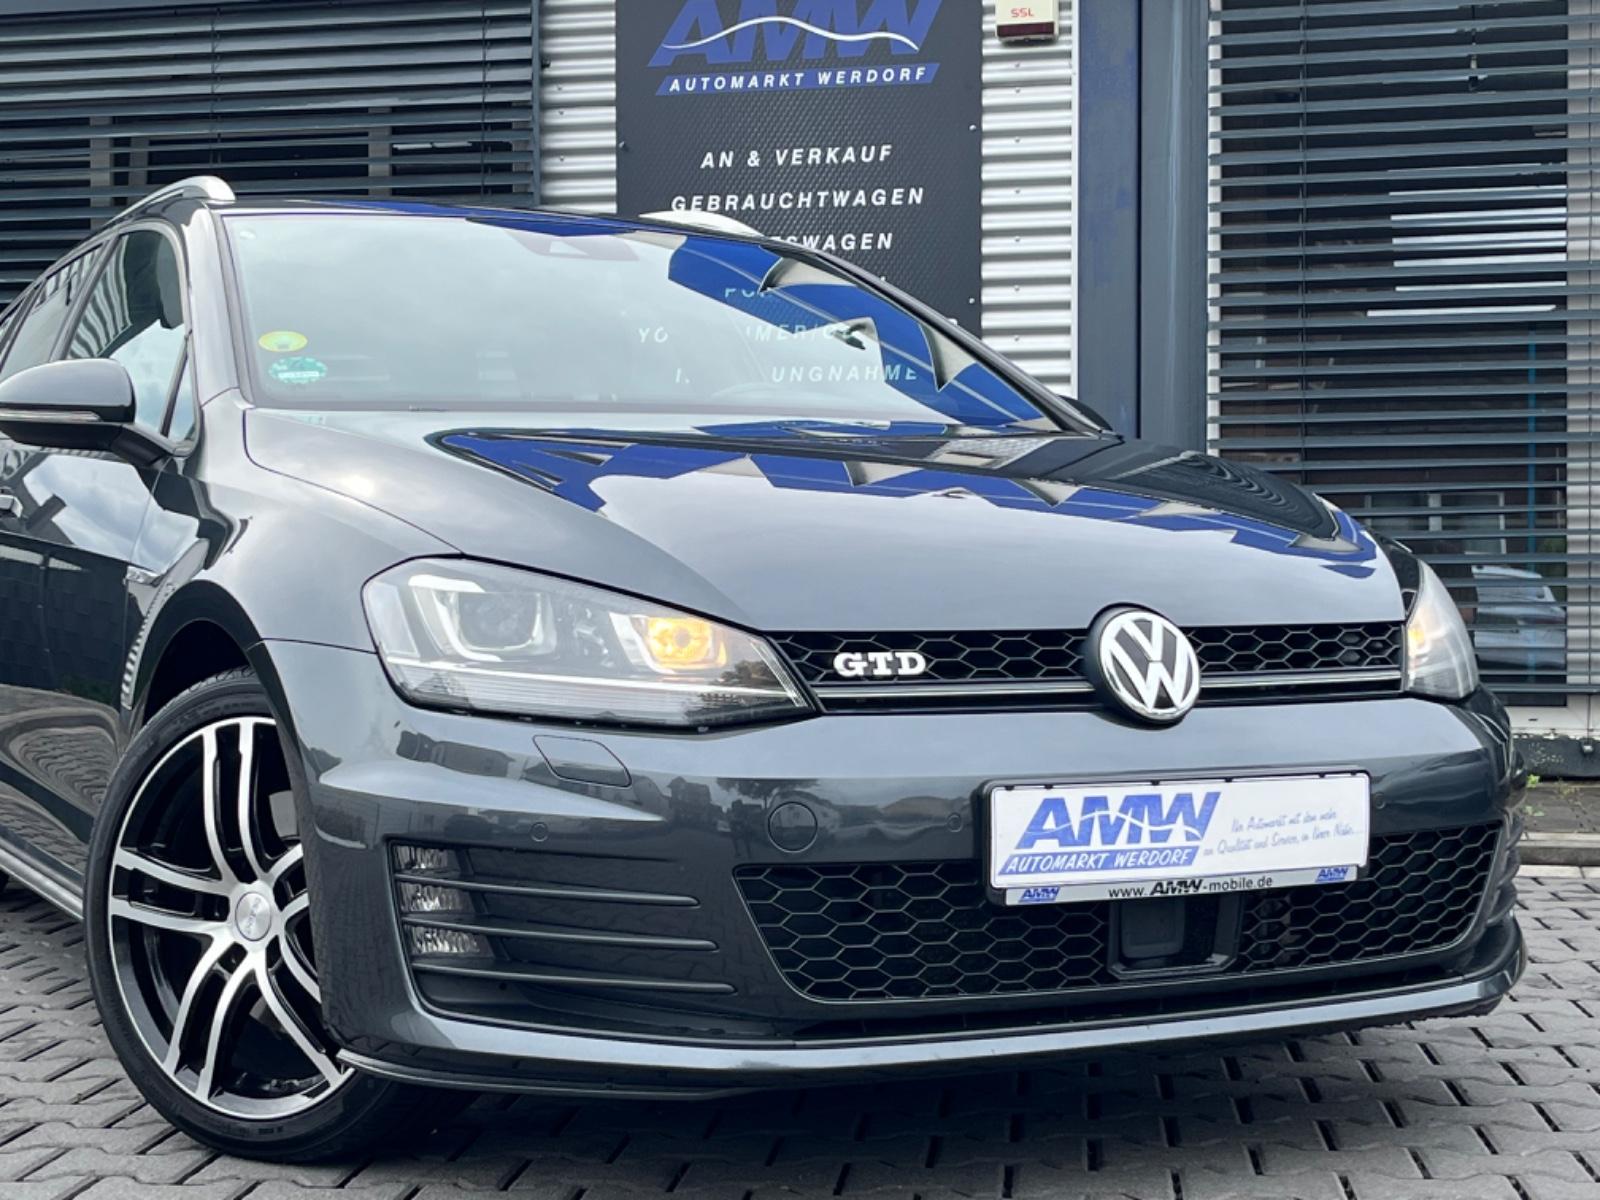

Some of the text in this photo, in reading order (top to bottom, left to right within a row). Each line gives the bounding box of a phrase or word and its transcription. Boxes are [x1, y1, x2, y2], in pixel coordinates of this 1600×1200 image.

[647, 0, 942, 66] AMW
[669, 66, 927, 92] AUTOMARKT WERDORF
[700, 144, 893, 169] AN & VERKAUF
[671, 187, 924, 212] GEBRAUCHTWAGEN
[832, 650, 928, 678] GTD
[1015, 791, 1221, 850] AMW
[1006, 849, 1194, 874] AUTOMARKT WERDORF
[1107, 876, 1274, 898] www.AMW-mobile.de
